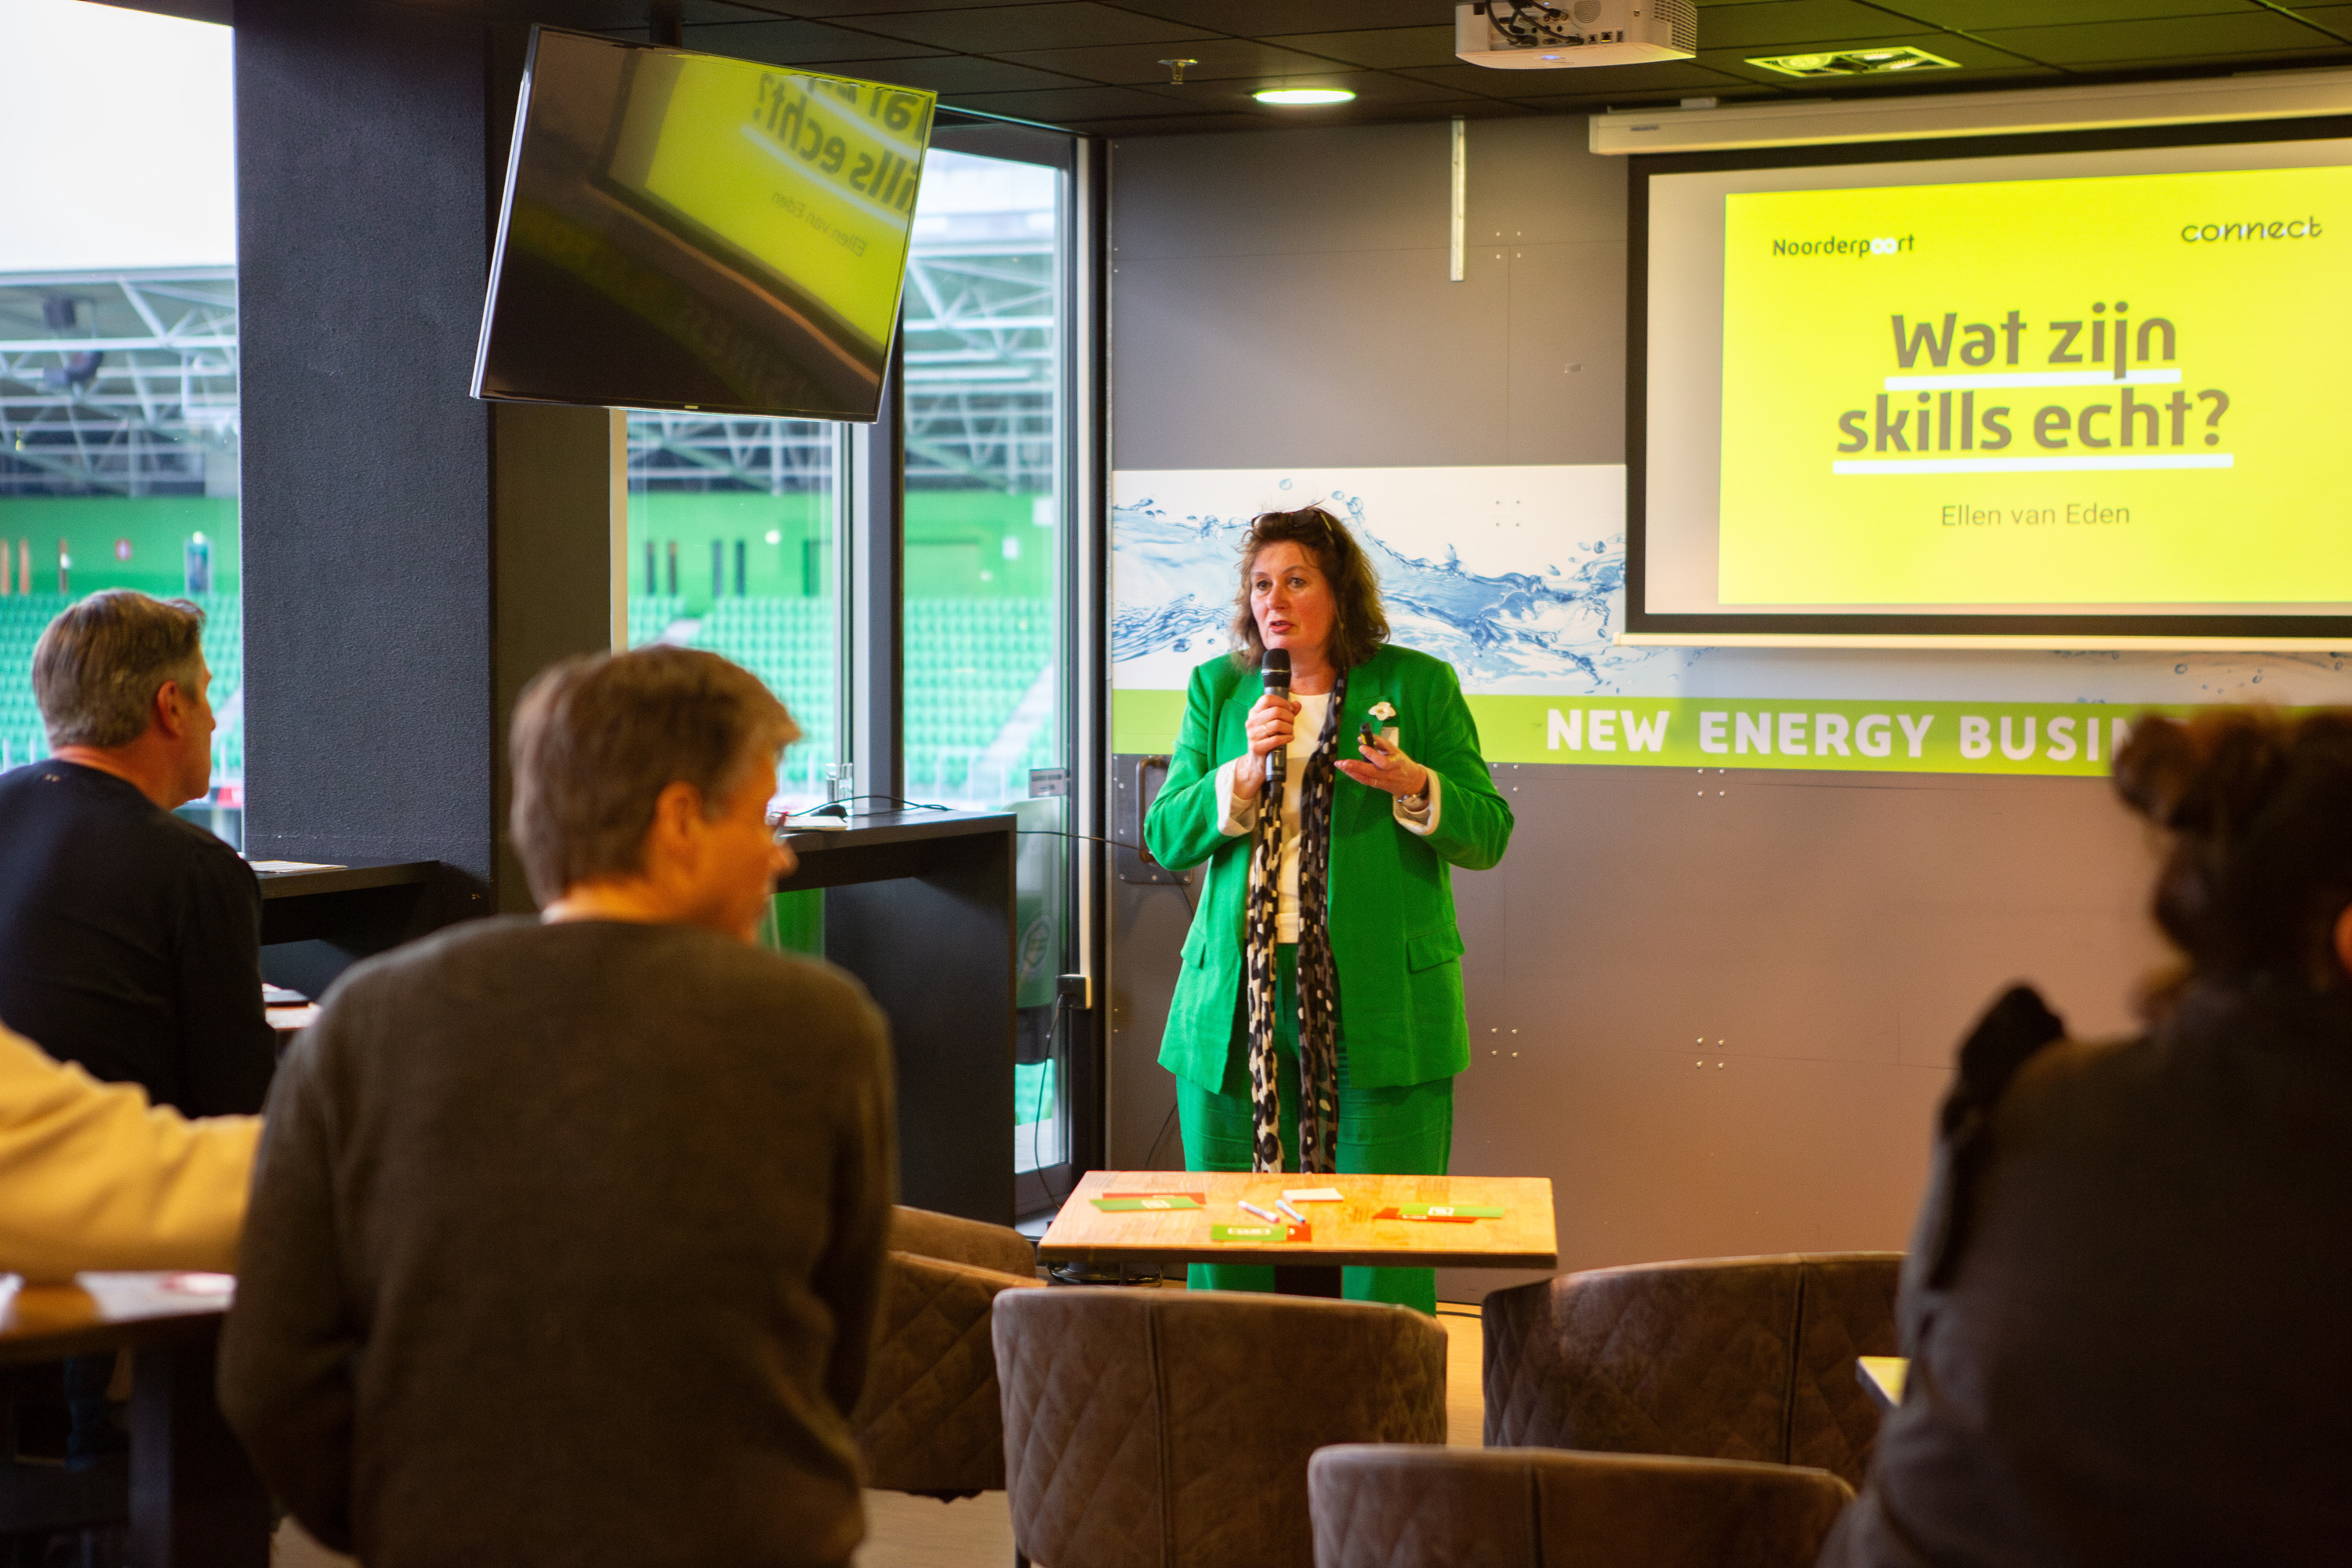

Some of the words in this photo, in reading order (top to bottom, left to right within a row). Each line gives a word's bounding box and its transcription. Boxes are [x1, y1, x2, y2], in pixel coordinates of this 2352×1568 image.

[1773, 234, 1915, 258] Noorderpoort
[2181, 216, 2323, 243] connect
[1891, 310, 2027, 368] Wat
[2048, 301, 2176, 379] zijn
[1837, 390, 2012, 452] skills
[2034, 387, 2230, 448] echt?
[1941, 504, 2001, 526] Ellen
[2011, 509, 2056, 525] van
[2066, 503, 2129, 524] Eden
[1546, 709, 1670, 753] NEW
[1699, 711, 1934, 758] ENERGY
